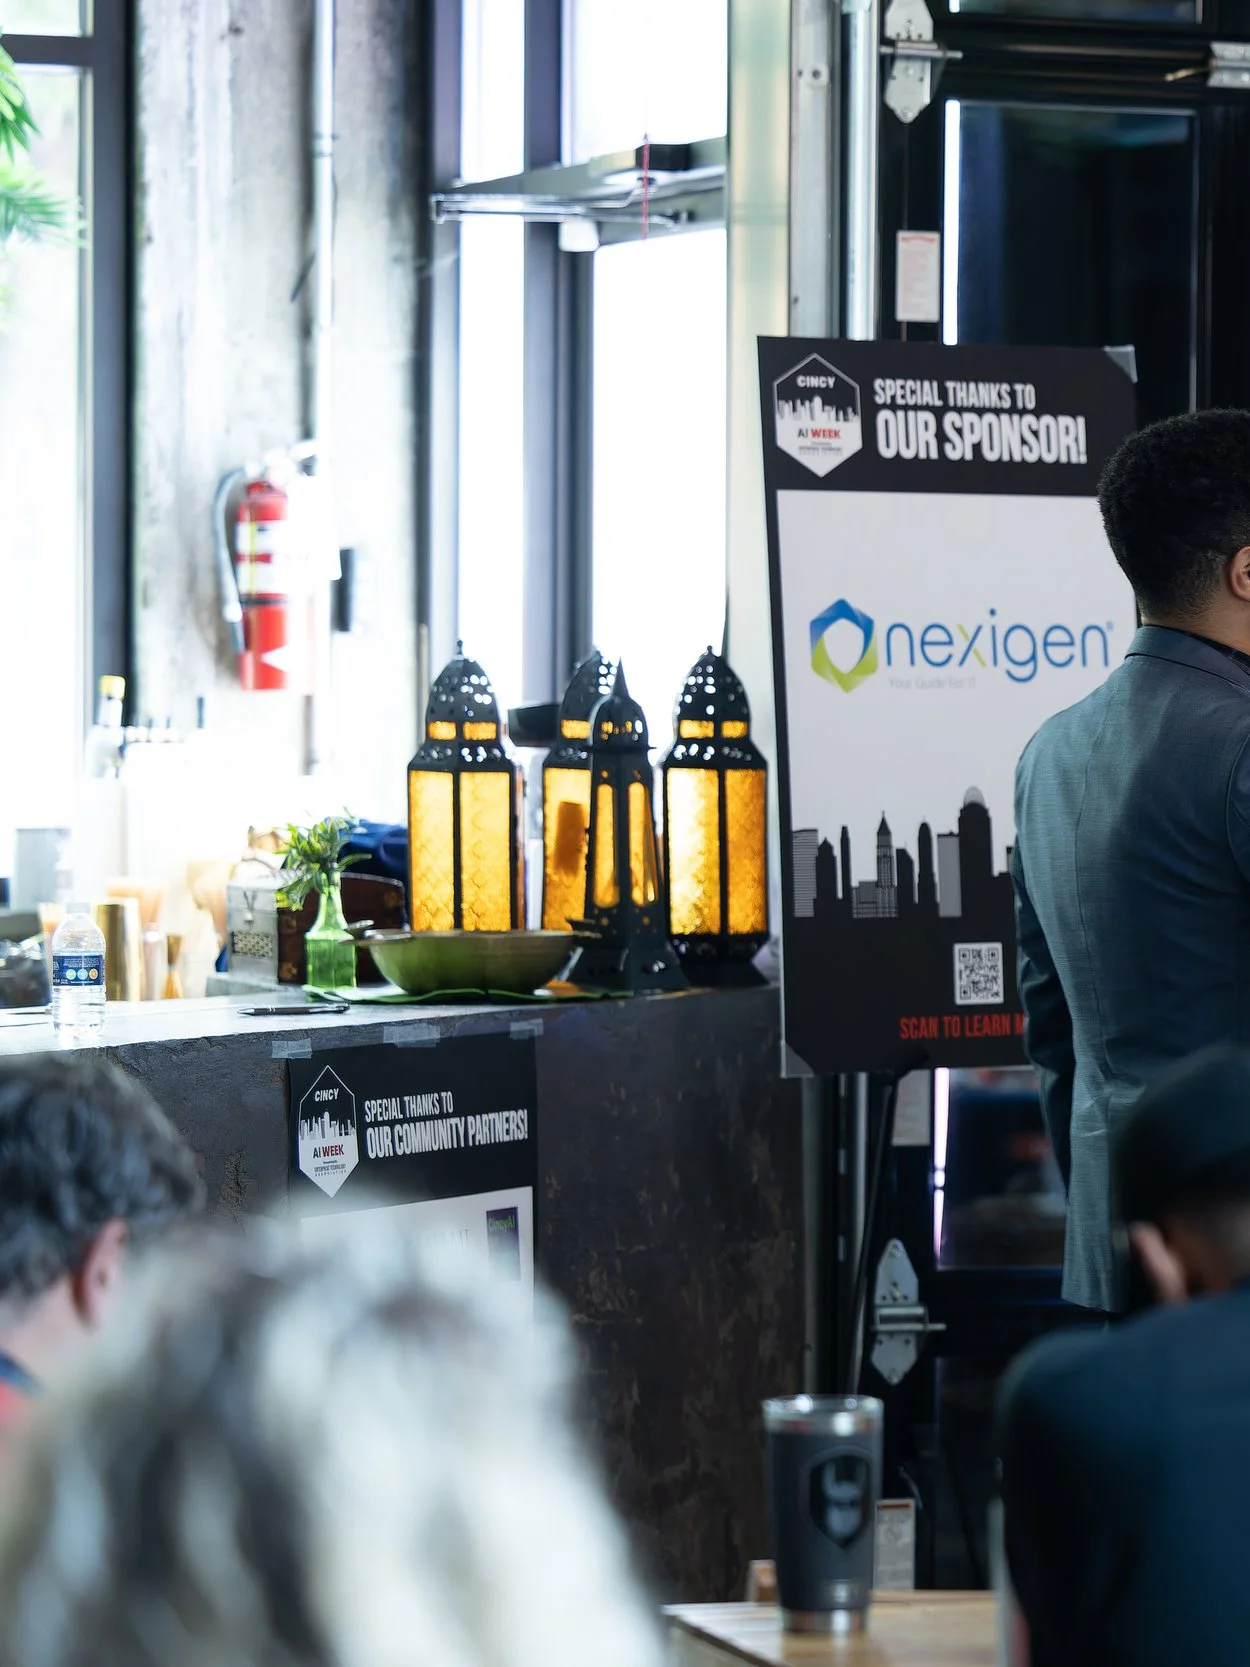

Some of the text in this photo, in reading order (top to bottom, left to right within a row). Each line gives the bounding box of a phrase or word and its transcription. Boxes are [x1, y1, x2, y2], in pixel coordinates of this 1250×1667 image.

[796, 376, 836, 389] CINCY
[873, 378, 1037, 411] SPECIAL THANKS TO
[797, 428, 841, 439] AI WEEK
[875, 409, 1088, 464] OUR SPONSOR!
[886, 608, 1110, 683] nexigen
[900, 1016, 938, 1040] SCAN
[943, 1015, 960, 1038] TO
[964, 1013, 1011, 1037] LEARN
[314, 1088, 339, 1102] CINCY
[365, 1091, 453, 1122] SPECIAL THANKS TO
[367, 1109, 528, 1159] OUR COMMUNITY PARTNERS!
[313, 1144, 344, 1158] AI WEEK
